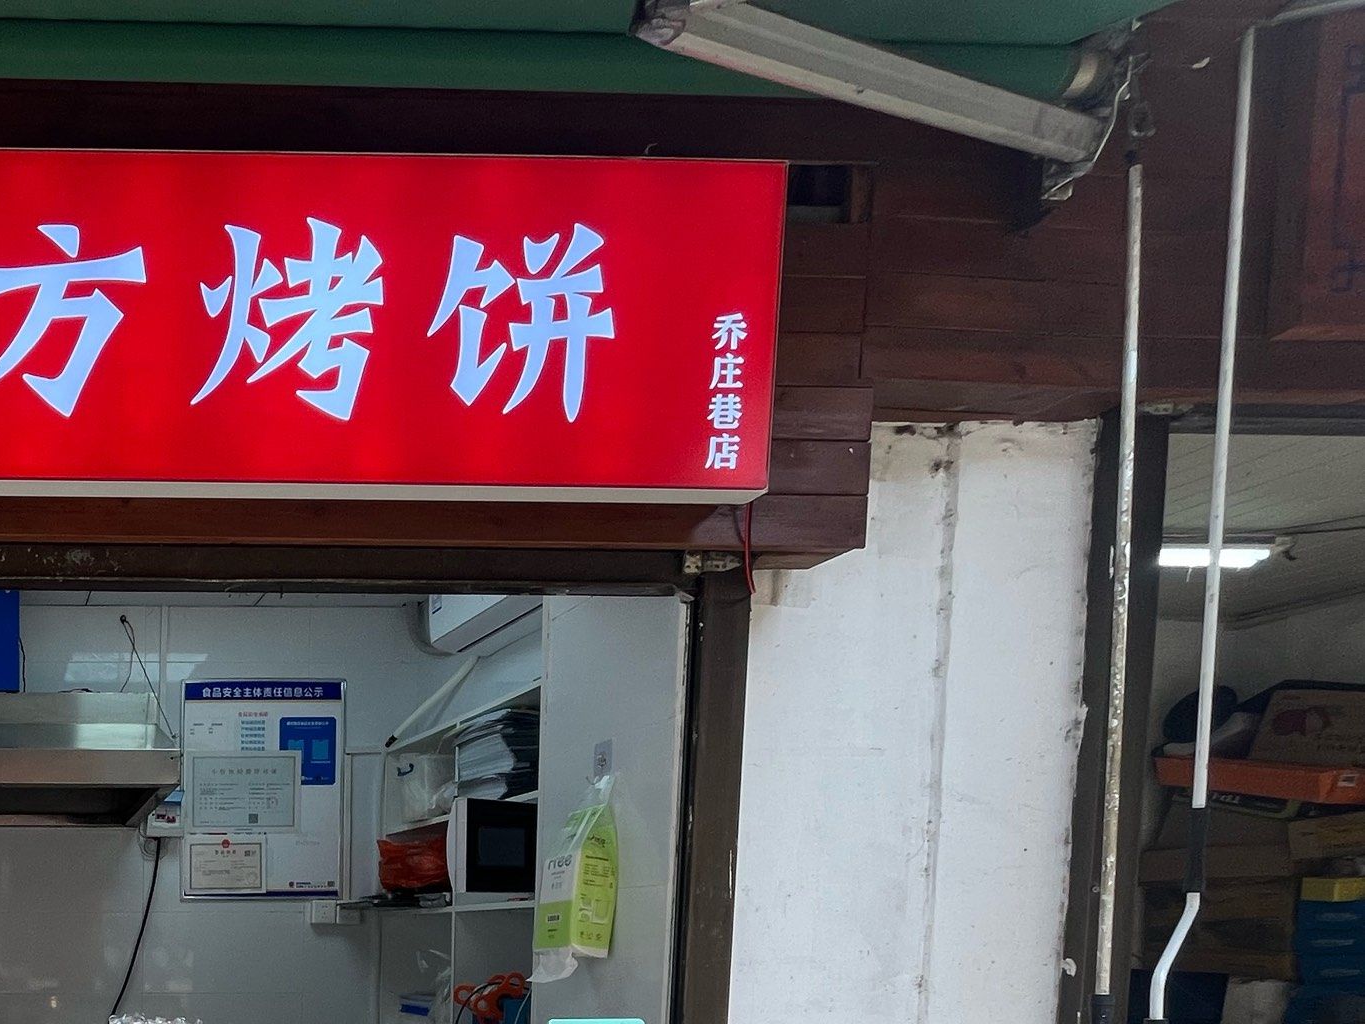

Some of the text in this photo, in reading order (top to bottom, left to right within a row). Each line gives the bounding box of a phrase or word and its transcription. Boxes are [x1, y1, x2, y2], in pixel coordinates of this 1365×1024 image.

[704, 312, 748, 471] 乔庄巷店
[202, 687, 324, 698] 食品安全主体责任信息公示
